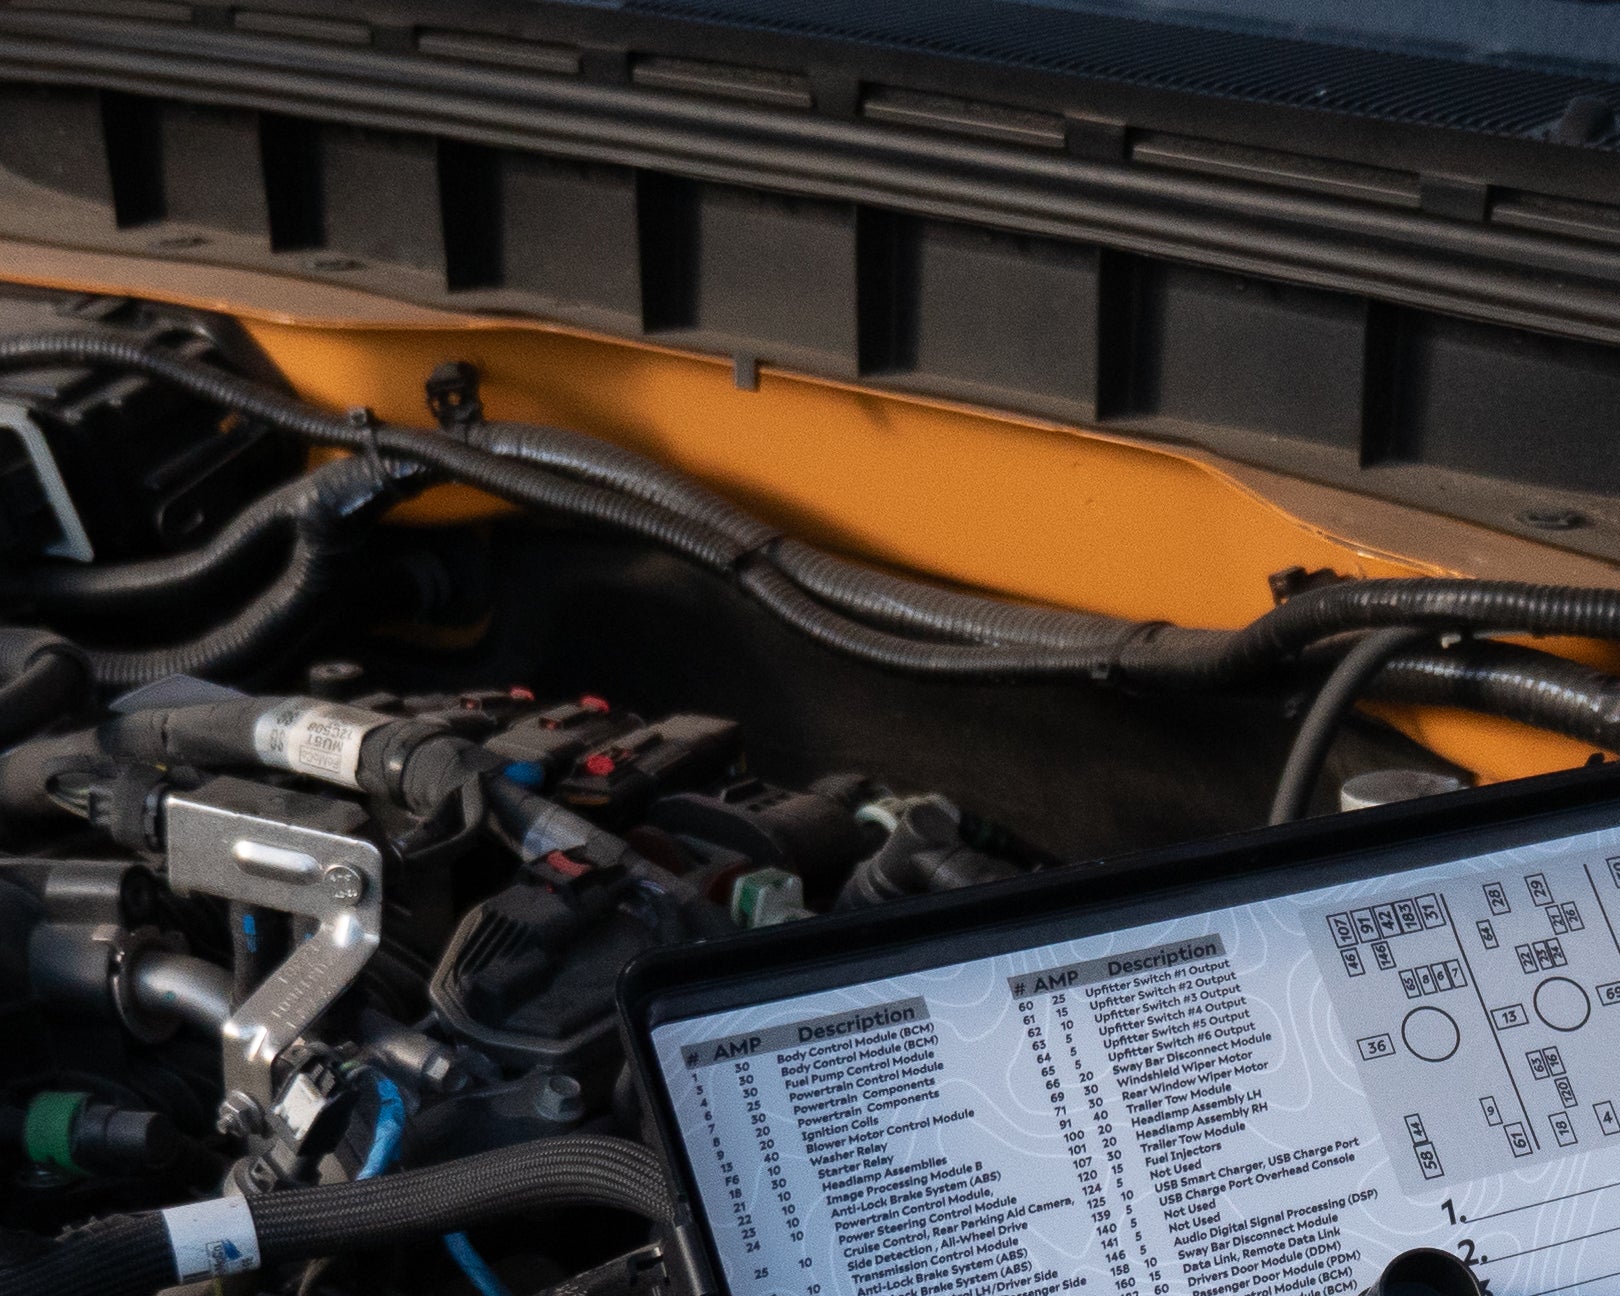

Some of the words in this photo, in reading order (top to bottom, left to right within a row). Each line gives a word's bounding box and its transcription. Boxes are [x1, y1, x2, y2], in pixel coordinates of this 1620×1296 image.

[1488, 889, 1505, 907] 28
[1530, 879, 1547, 897] 29
[1356, 917, 1374, 934] 91
[1377, 910, 1394, 930] 42
[1397, 903, 1417, 929] 183
[1421, 904, 1439, 920] 31
[1333, 918, 1352, 942] 107
[1014, 982, 1025, 996] #
[1033, 970, 1078, 993] AMP
[1107, 943, 1217, 976] Description
[1018, 1000, 1034, 1012] 60
[1051, 993, 1066, 1005] 25
[1084, 981, 1131, 998] Upfitter
[1132, 971, 1172, 988] Switch
[1173, 968, 1186, 978] #1
[1188, 959, 1230, 975] Output
[1501, 1010, 1517, 1024] 13
[686, 1052, 699, 1066] #
[713, 1036, 761, 1061] AMP
[797, 1007, 915, 1043] Description
[691, 1073, 698, 1082] 1
[734, 1061, 750, 1073] 30
[776, 1050, 807, 1064] Body
[808, 1039, 853, 1057] Control
[854, 1030, 897, 1048] Module
[899, 1022, 934, 1039] (BCM)
[1367, 1039, 1386, 1054] 36
[703, 1110, 713, 1121] 6
[746, 1099, 761, 1112] 25
[788, 1080, 854, 1102] Powertrain
[855, 1069, 900, 1088] Control
[901, 1061, 944, 1078] Module
[1050, 1091, 1065, 1103] 69
[1083, 1083, 1099, 1096] 30
[1116, 1064, 1180, 1088] Windshield
[1181, 1059, 1216, 1073] Wiper
[1217, 1051, 1253, 1065] Motor
[715, 1149, 725, 1161] 9
[759, 1138, 775, 1151] 20
[800, 1124, 849, 1142] Ignition
[850, 1115, 879, 1130] Coils
[1067, 1143, 1086, 1156] 101
[1101, 1136, 1117, 1149] 20
[1135, 1120, 1194, 1140] Headlamp
[1196, 1106, 1249, 1126] Assembly
[1251, 1101, 1268, 1114] RH
[1510, 1132, 1527, 1148] 61
[724, 1174, 740, 1187] F6
[767, 1164, 781, 1177] 10
[809, 1150, 855, 1167] Washer
[856, 1142, 888, 1157] Relay
[1077, 1169, 1098, 1182] 120
[1111, 1163, 1124, 1175] 15
[1144, 1151, 1169, 1167] Fuel
[1170, 1142, 1222, 1161] Injectors
[1086, 1196, 1106, 1209] 125
[1120, 1189, 1134, 1201] 10
[1154, 1179, 1178, 1193] USB
[1180, 1170, 1216, 1187] Smart
[1217, 1161, 1266, 1178] Charger,
[1267, 1152, 1291, 1166] USB
[1292, 1144, 1333, 1160] Charge
[1334, 1136, 1360, 1150] Port
[1419, 1150, 1437, 1169] 58
[736, 1213, 752, 1227] 22
[781, 1203, 796, 1215] 10
[825, 1190, 864, 1206] Image
[865, 1175, 928, 1196] Processing
[929, 1163, 973, 1181] Module
[974, 1160, 983, 1171] B
[1081, 1182, 1102, 1196] 124
[1116, 1177, 1123, 1188] 5
[1149, 1167, 1172, 1180] Not
[1173, 1158, 1202, 1174] Used
[1105, 1249, 1126, 1263] 146
[1139, 1244, 1147, 1255] 5
[1173, 1230, 1207, 1247] Audio
[1209, 1219, 1248, 1238] Digital
[1249, 1210, 1285, 1228] Signal
[1286, 1198, 1346, 1219] Processing
[1347, 1188, 1378, 1205] (DSP)
[1441, 1198, 1469, 1225] 1.
[1457, 1238, 1490, 1269] 2.
[1061, 1276, 1087, 1290] Side
